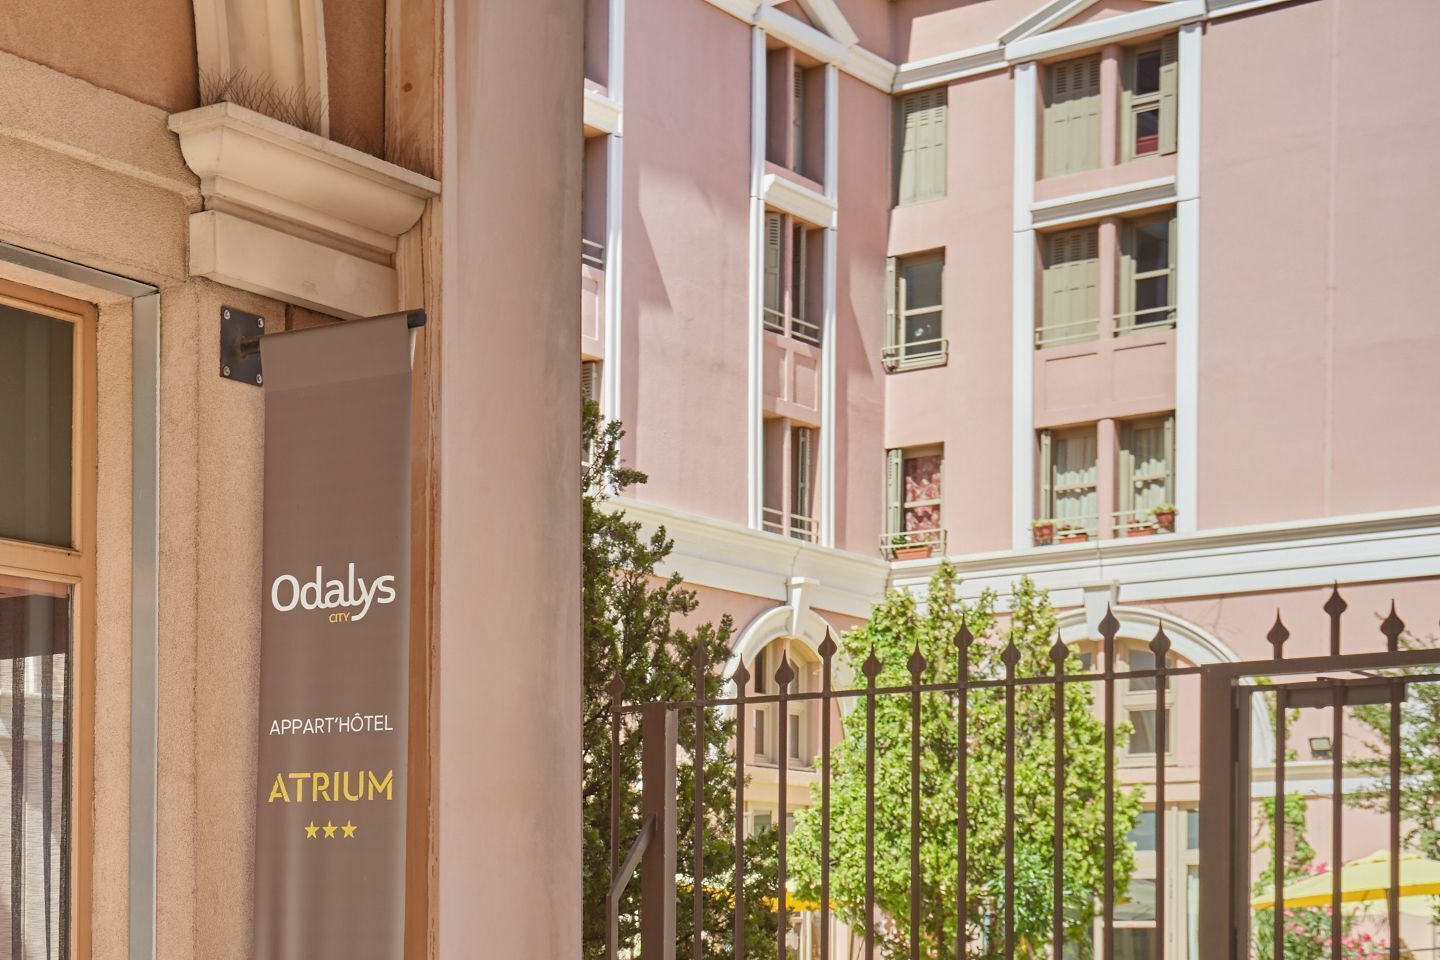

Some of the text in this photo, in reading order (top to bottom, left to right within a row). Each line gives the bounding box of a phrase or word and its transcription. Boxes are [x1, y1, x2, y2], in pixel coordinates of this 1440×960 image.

[270, 562, 397, 622] Odalys
[328, 612, 351, 623] CITY
[269, 712, 394, 736] APPART'HÔTEL
[268, 769, 393, 803] ATRIUM
